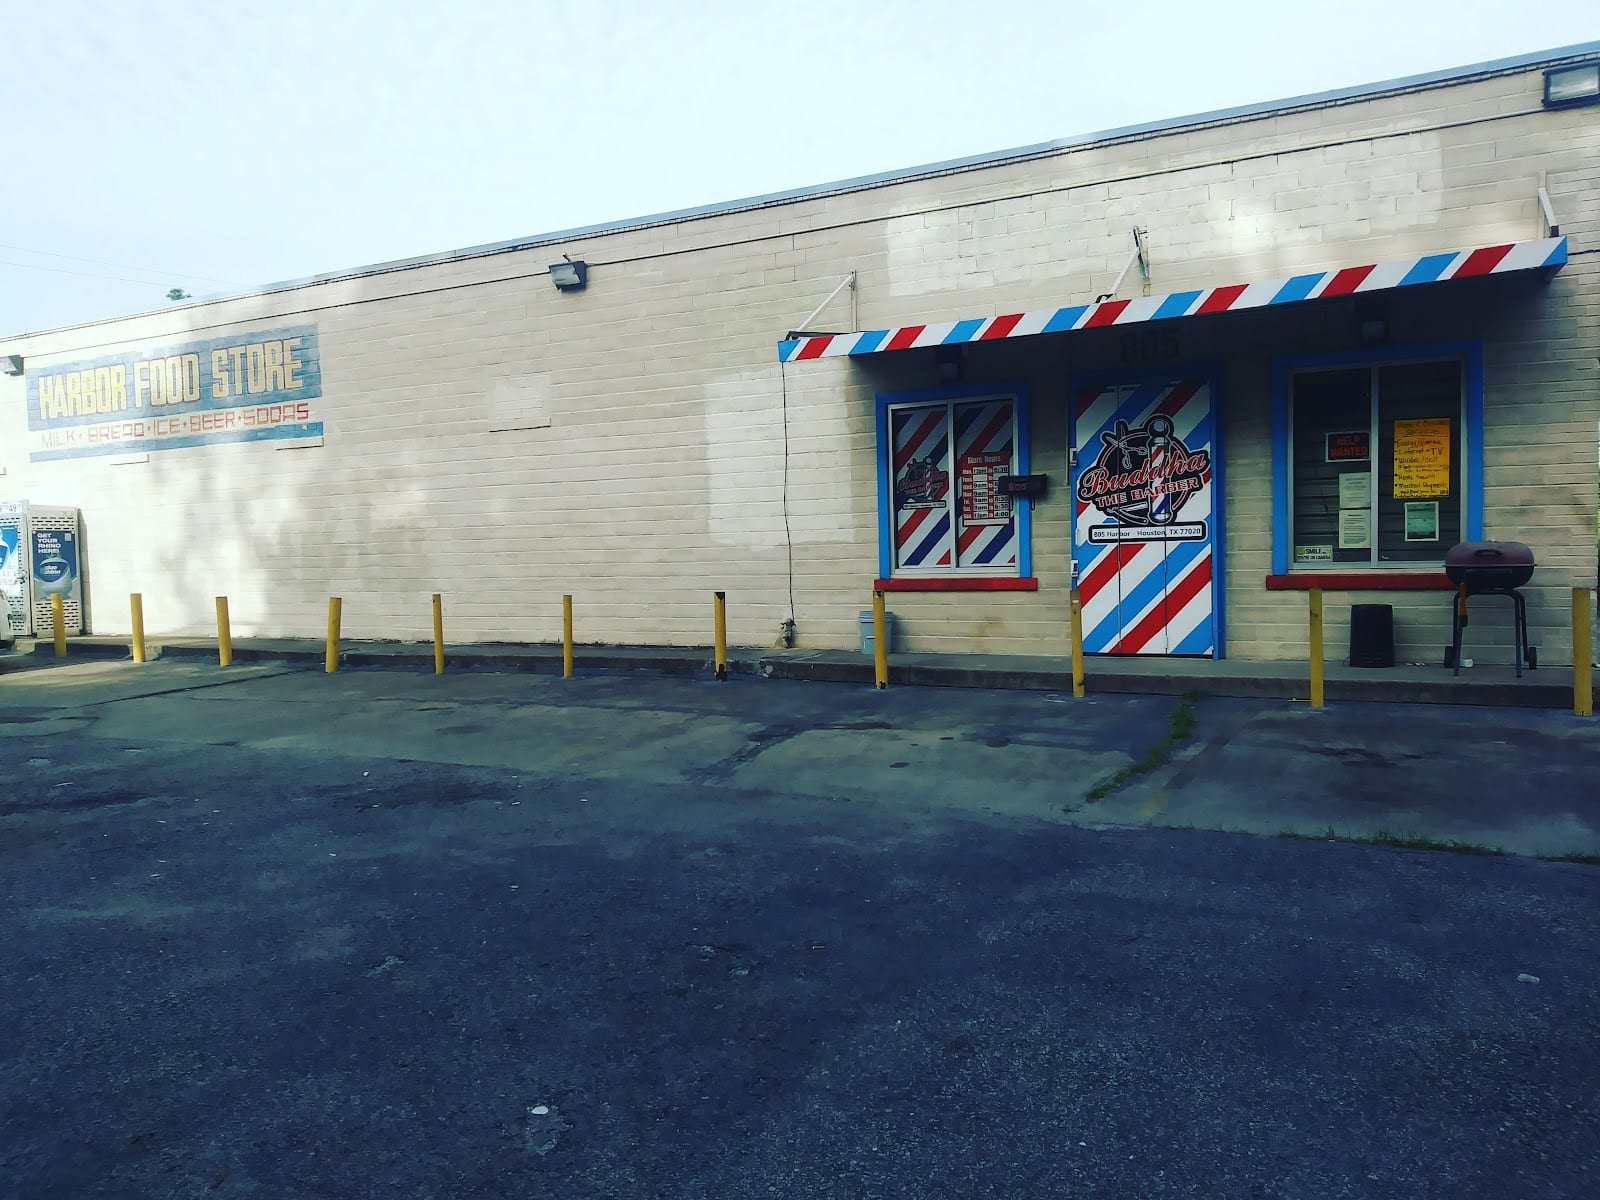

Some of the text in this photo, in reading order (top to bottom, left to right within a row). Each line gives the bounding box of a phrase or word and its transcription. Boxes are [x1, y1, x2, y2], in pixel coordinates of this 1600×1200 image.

[38, 338, 304, 420] HARBOR FOOD STORE
[41, 402, 309, 448] MILK BREAD ICE BEER SODAS
[1336, 435, 1361, 445] HELP
[1330, 446, 1367, 457] WANTED
[1081, 451, 1205, 497] Buddha
[1096, 478, 1199, 508] THE BARBER
